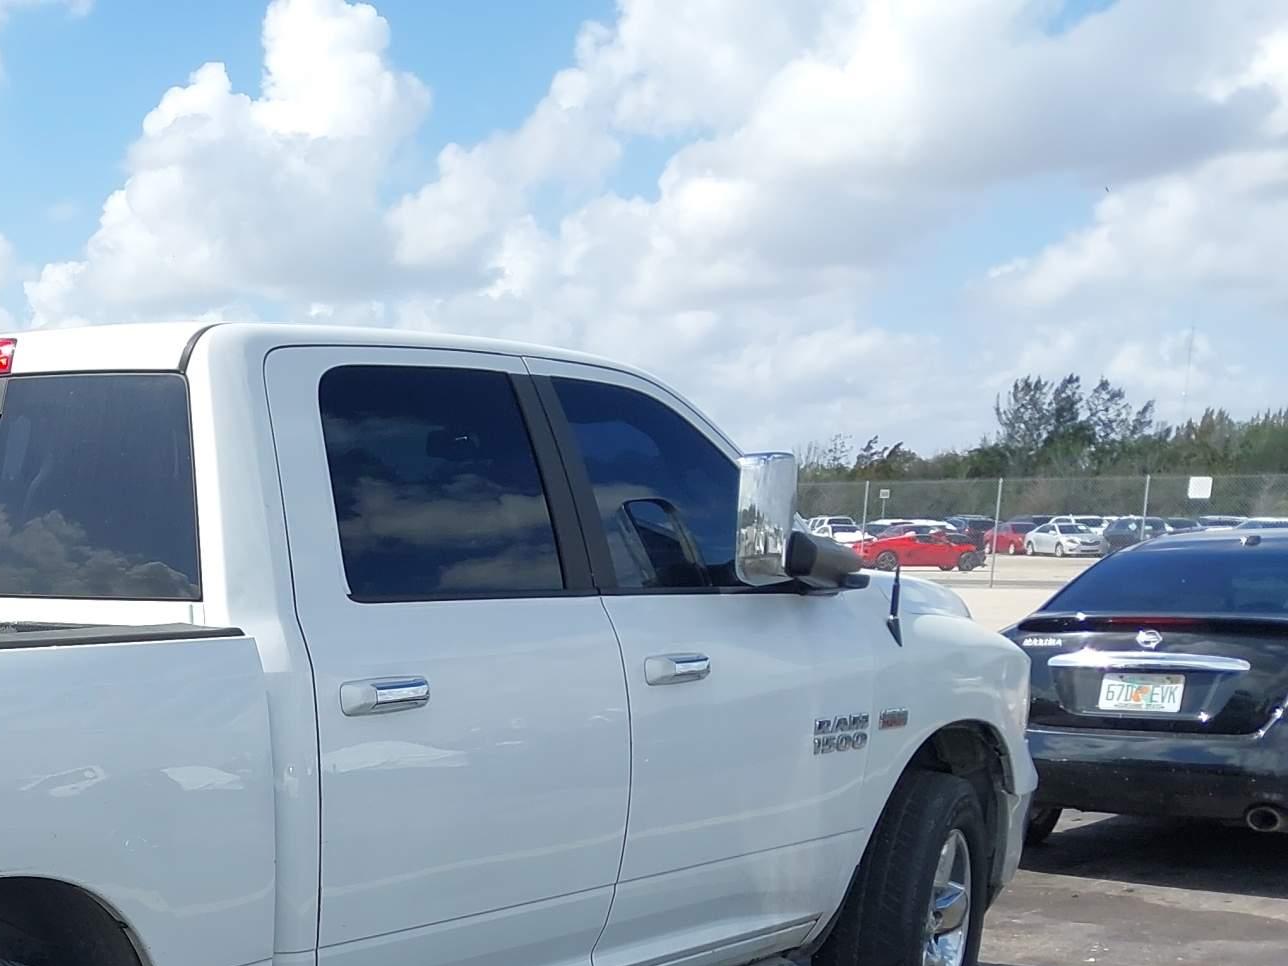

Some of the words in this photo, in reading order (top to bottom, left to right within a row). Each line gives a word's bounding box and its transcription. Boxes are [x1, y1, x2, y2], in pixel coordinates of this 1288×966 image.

[1150, 686, 1178, 704] EVK
[814, 713, 869, 735] RAM
[813, 731, 868, 756] 1500
